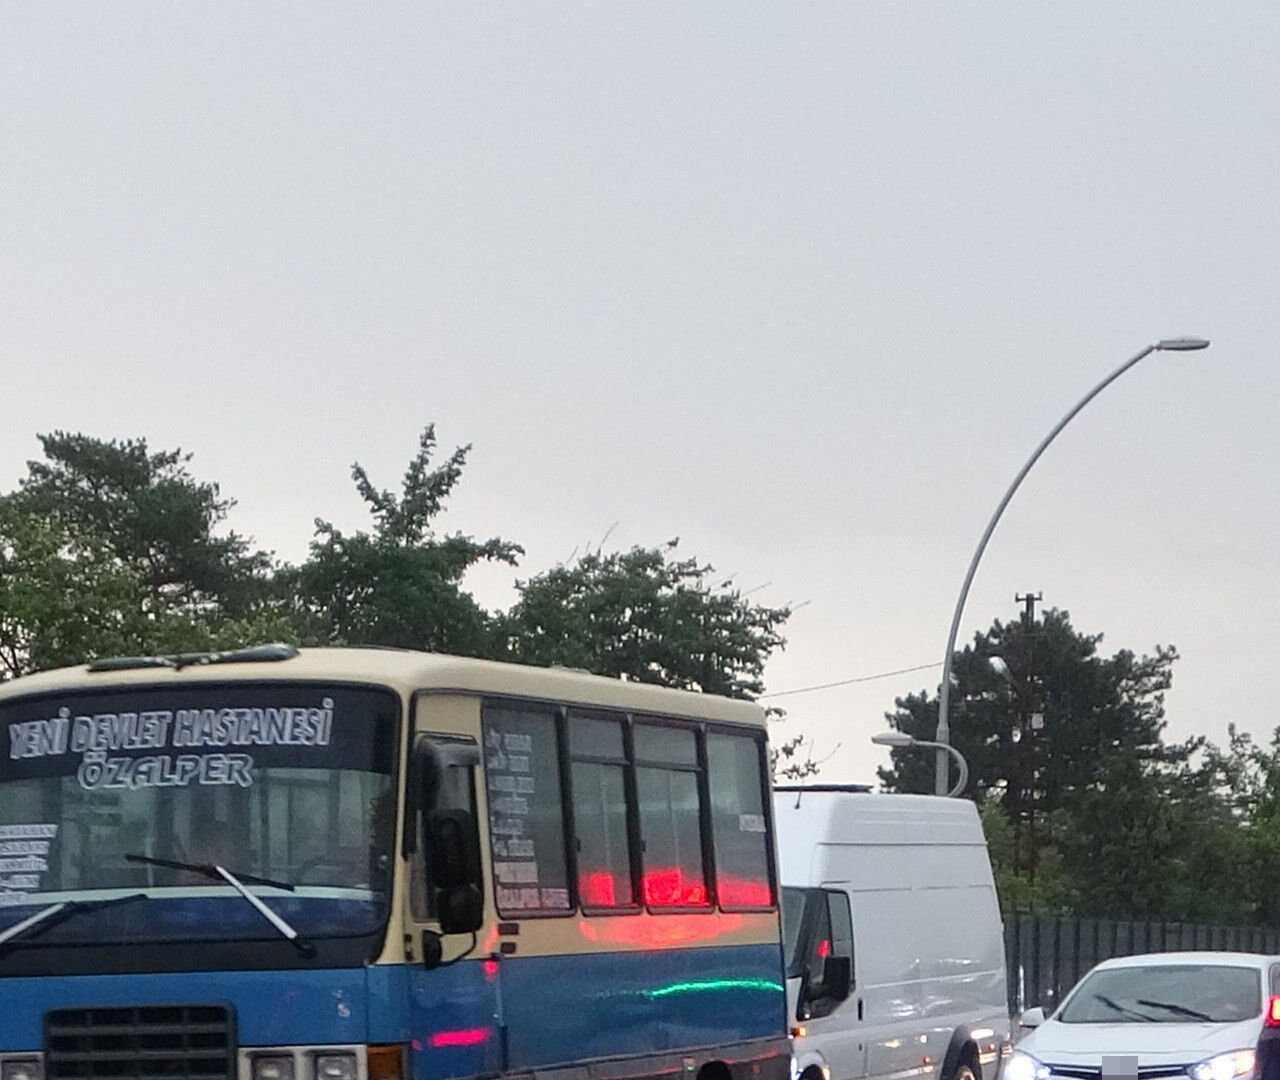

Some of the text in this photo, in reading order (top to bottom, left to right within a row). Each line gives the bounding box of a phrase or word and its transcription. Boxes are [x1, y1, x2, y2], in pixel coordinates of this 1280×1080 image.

[8, 697, 334, 759] YENİ DEVLET HASTANESİ
